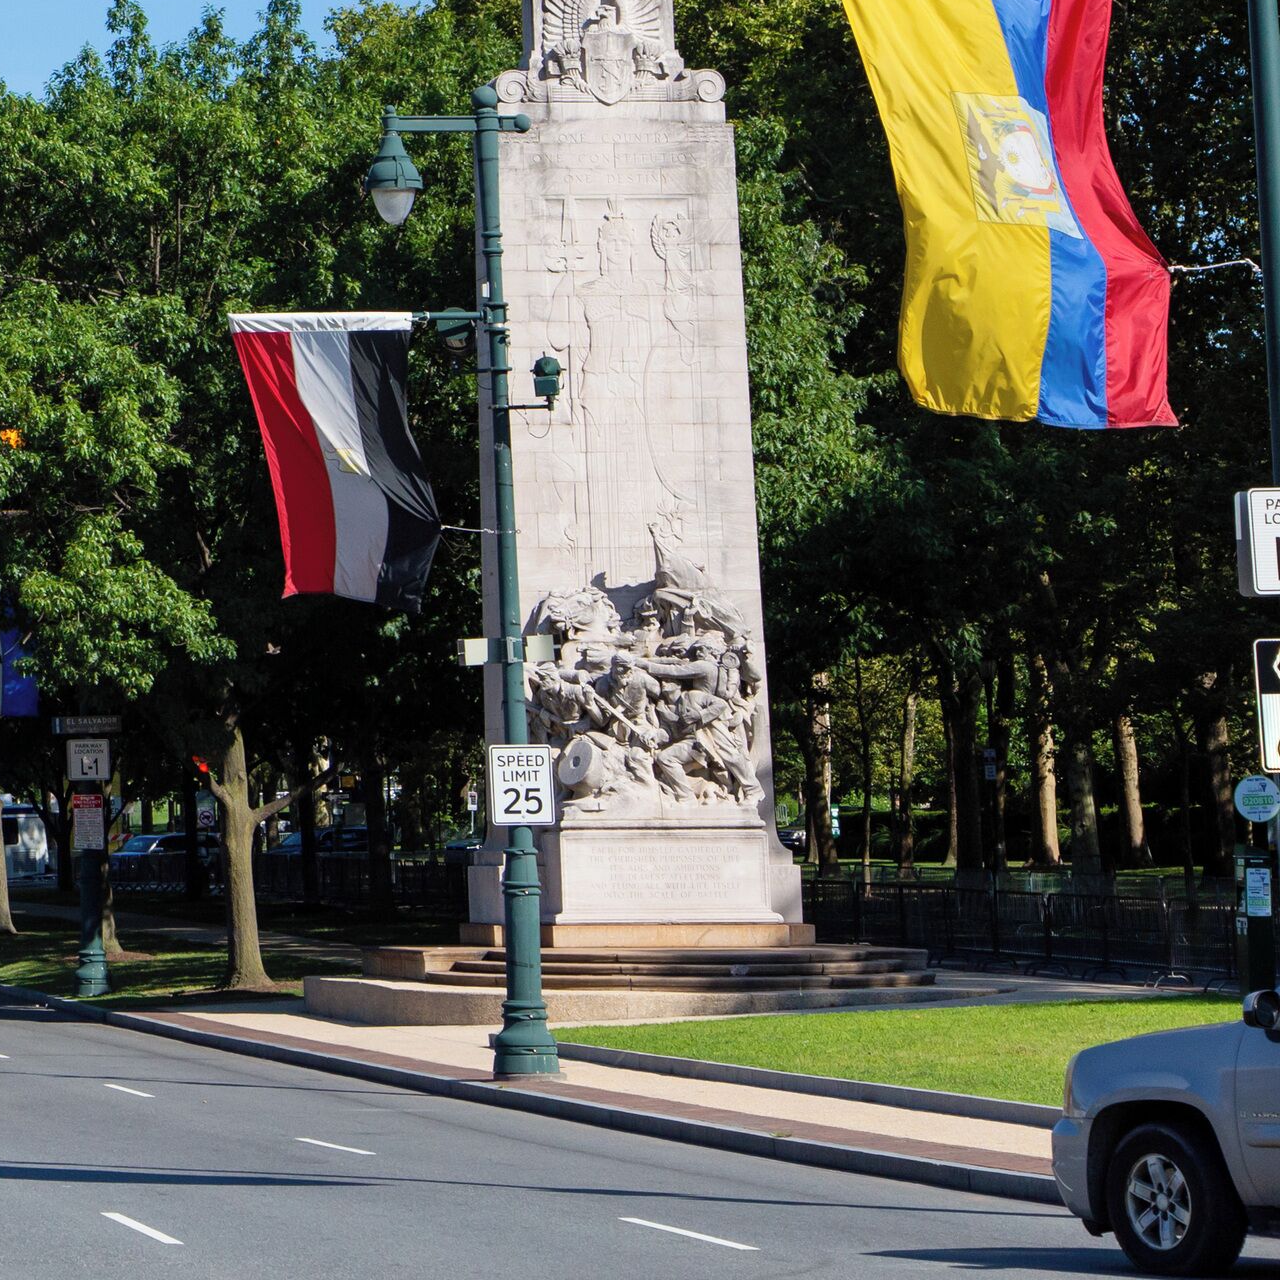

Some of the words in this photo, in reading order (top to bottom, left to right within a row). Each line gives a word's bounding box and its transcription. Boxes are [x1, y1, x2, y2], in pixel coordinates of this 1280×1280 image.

[558, 133, 585, 144] ONE
[600, 132, 670, 144] COUNTRY
[532, 152, 561, 163] ONE
[578, 152, 697, 163] CONSTITUTION
[563, 174, 591, 184] ONE
[607, 174, 668, 185] DESTINY
[78, 716, 118, 725] SALVADOR
[80, 757, 99, 776] L-1
[497, 755, 545, 767] SPEED
[502, 770, 540, 782] LIMIT
[503, 787, 543, 815] 25
[659, 855, 705, 863] PURPOSES
[706, 855, 719, 863] OF
